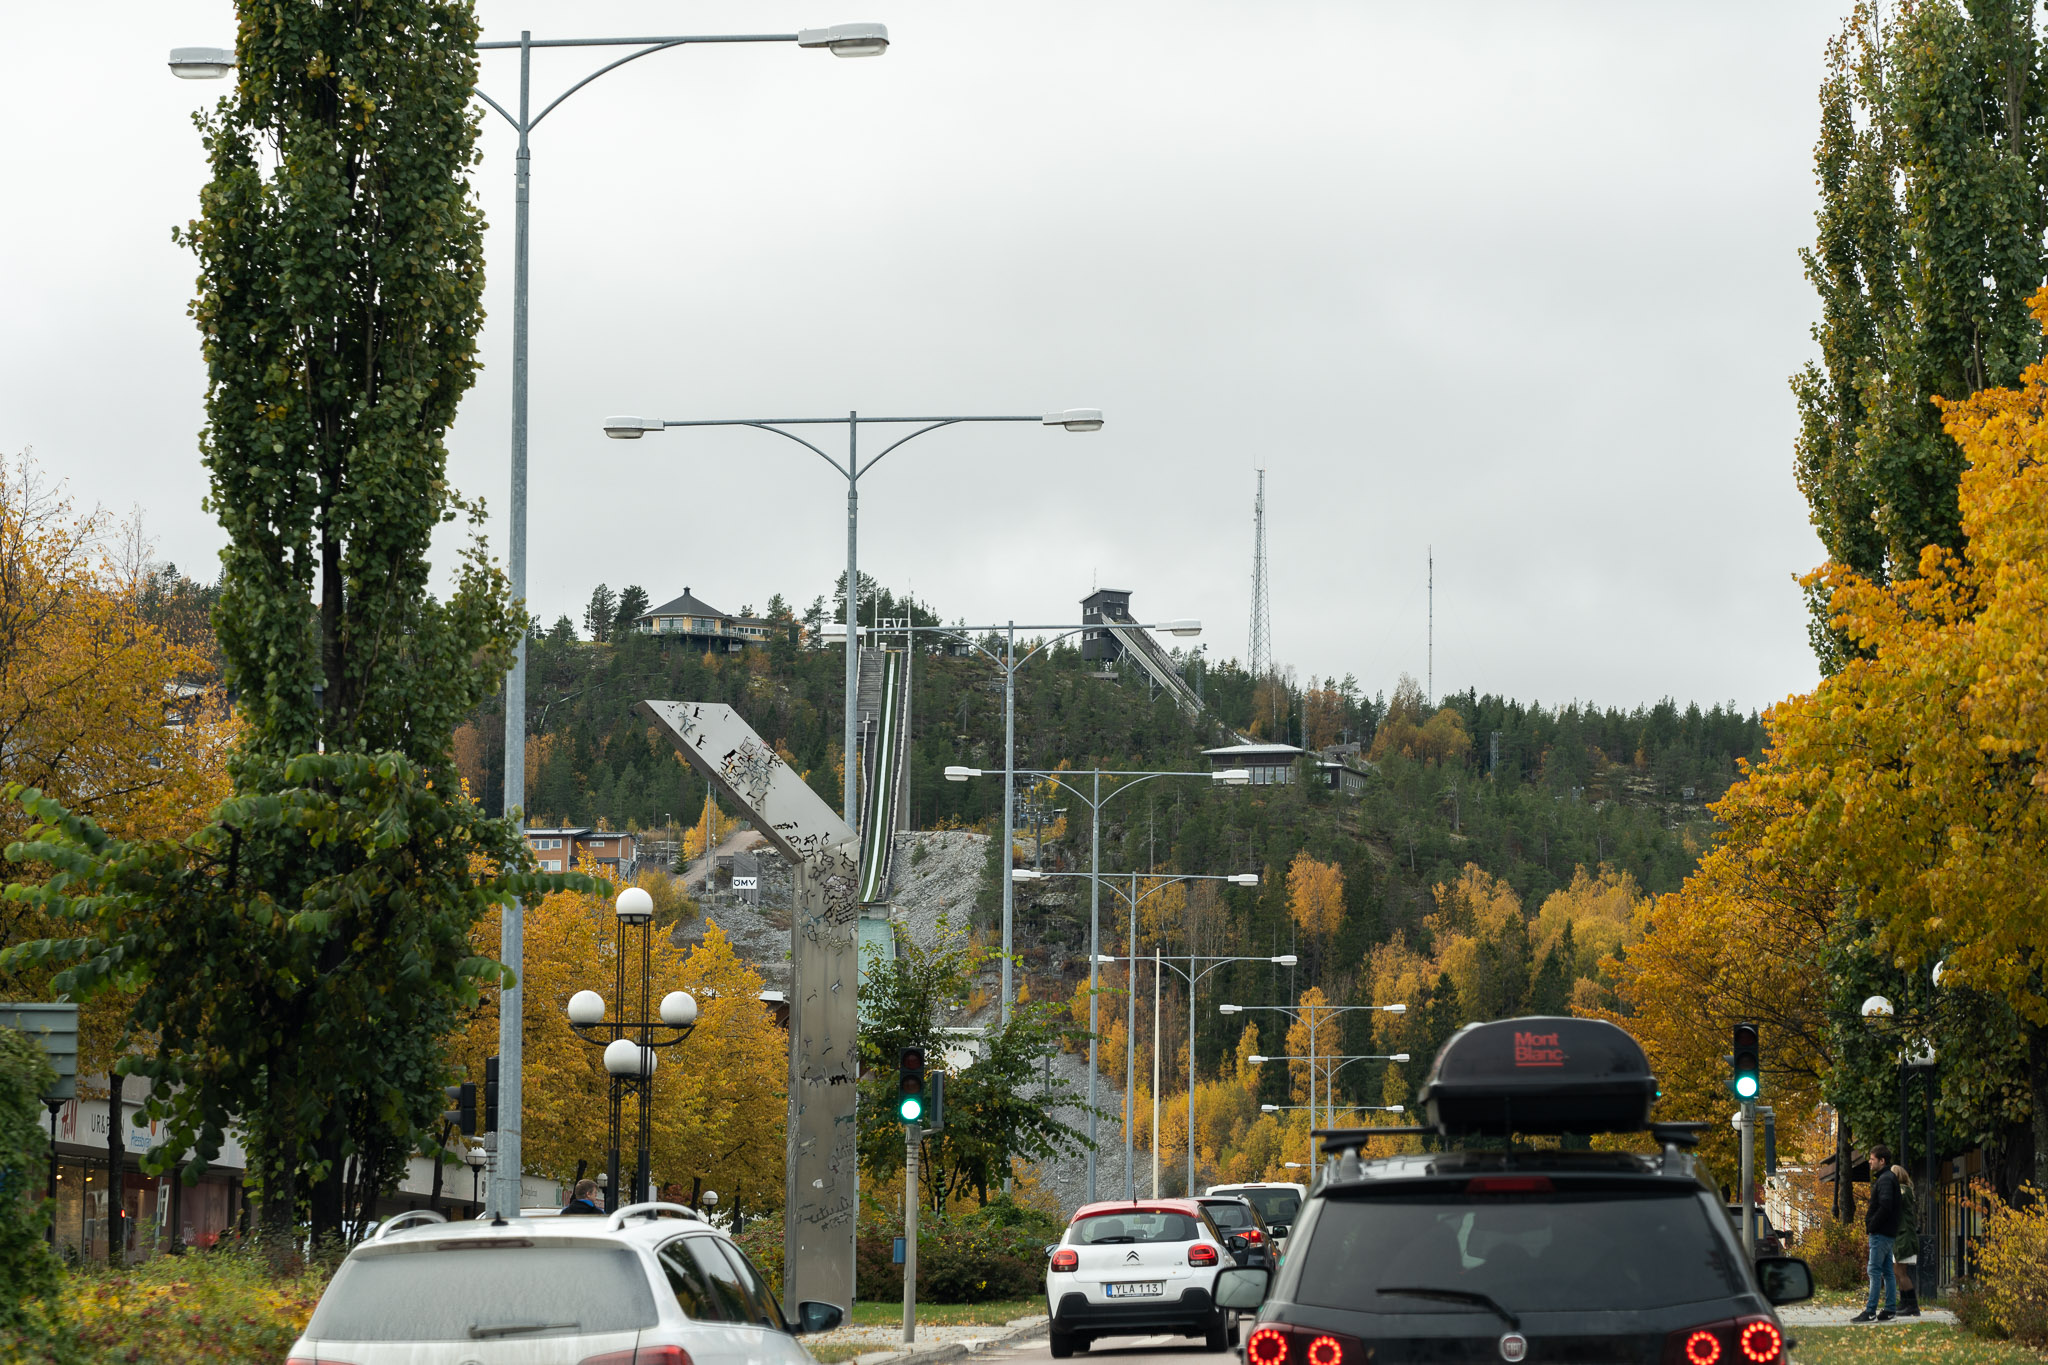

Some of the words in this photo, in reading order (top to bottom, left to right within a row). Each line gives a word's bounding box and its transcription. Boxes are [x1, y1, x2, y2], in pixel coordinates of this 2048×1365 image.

[733, 878, 756, 887] ÖMV
[1515, 1032, 1559, 1046] Mont
[1515, 1047, 1563, 1061] Blanc
[1116, 1284, 1135, 1294] YLA
[1139, 1283, 1158, 1293] 113
